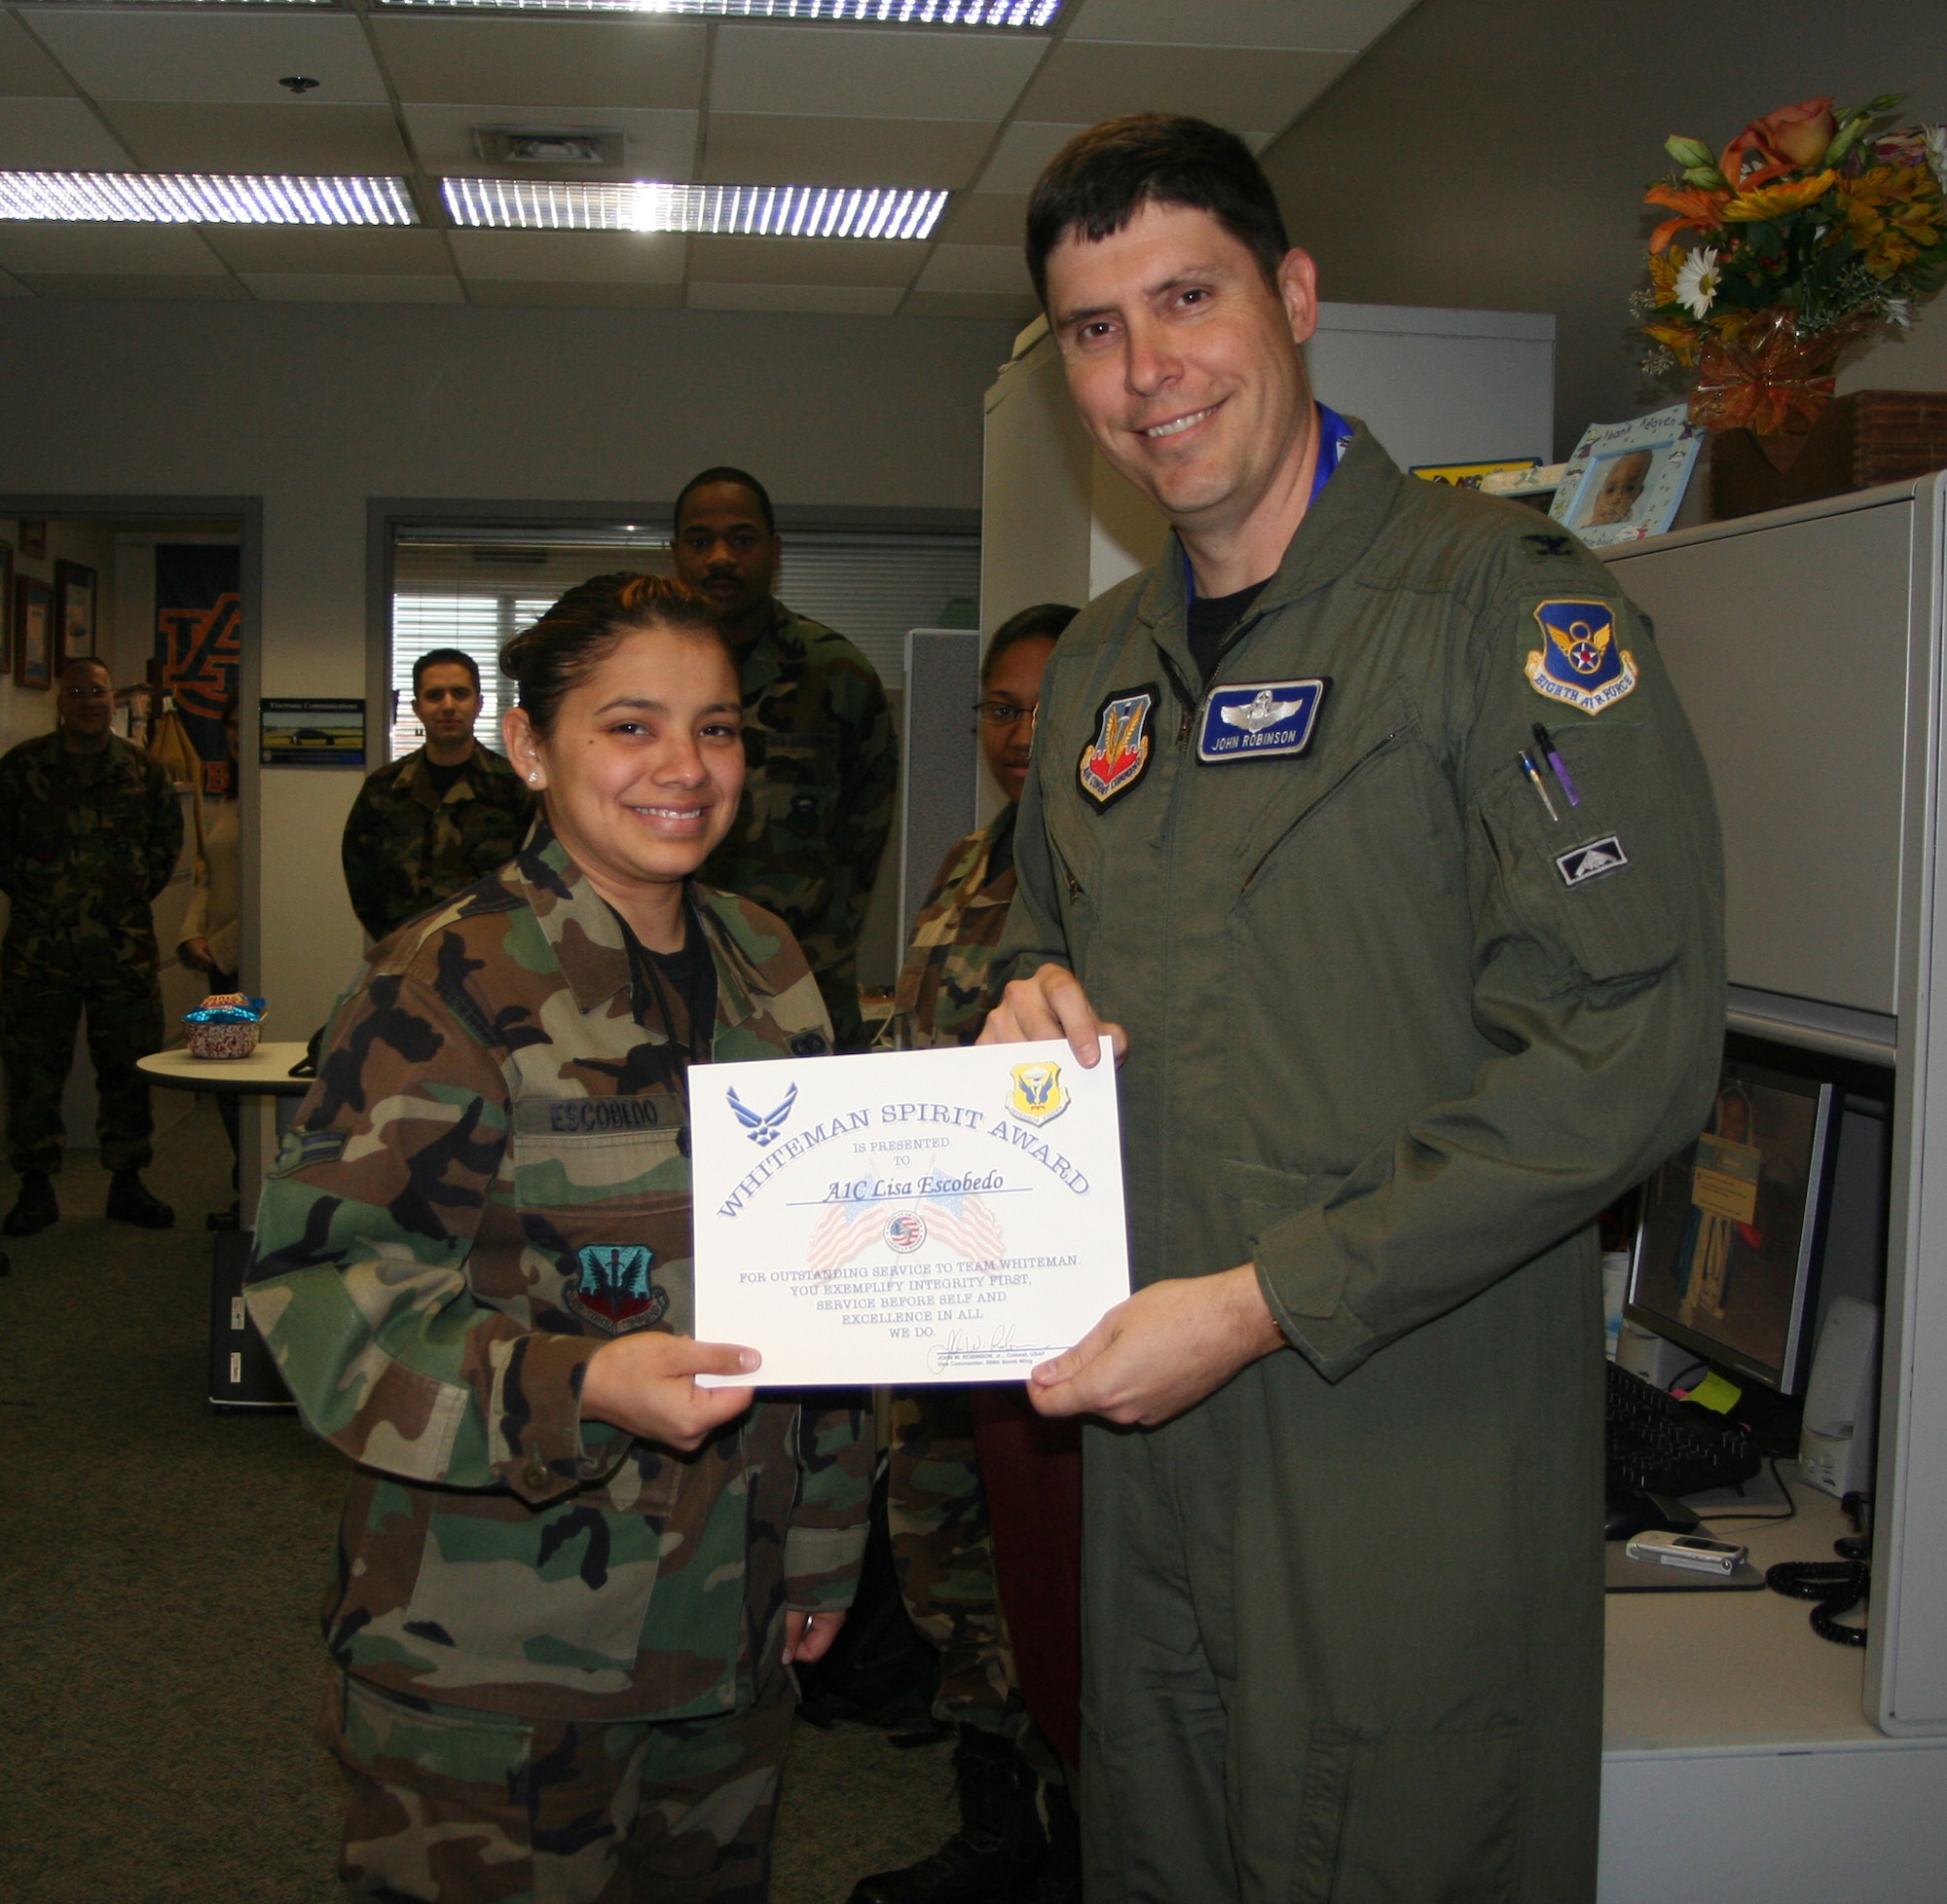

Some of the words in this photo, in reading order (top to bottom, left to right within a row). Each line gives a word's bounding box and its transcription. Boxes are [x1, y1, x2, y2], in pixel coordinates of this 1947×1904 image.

[1534, 674, 1579, 702] EIGHTH
[1580, 694, 1605, 710] AIR
[1601, 675, 1634, 701] FORCE
[1211, 735, 1239, 751] JOHN
[1241, 730, 1297, 748] ROBINSON
[550, 1099, 659, 1132] ESCOBEDO
[853, 1142, 866, 1153] IS
[870, 1137, 950, 1153] PRESENTED
[716, 1108, 871, 1218] WHITEMAN
[880, 1103, 984, 1130] SPIRIT
[986, 1120, 1090, 1196] AWARD
[893, 1154, 911, 1167] TO
[822, 1180, 868, 1203] A1C
[871, 1177, 913, 1198] Lisa
[916, 1169, 1004, 1195] Escobedo
[739, 1272, 767, 1283] FOR
[770, 1267, 868, 1282] OUTSTANDING
[872, 1263, 932, 1277] SERVICE
[936, 1263, 953, 1273] TO
[956, 1260, 997, 1273] TEAM
[790, 1285, 819, 1297] YOU
[823, 1281, 904, 1296] EXEMPLIFY
[908, 1276, 985, 1291] INTEGRITY
[989, 1273, 1032, 1287] FIRST,
[816, 1298, 876, 1311] SERVICE
[880, 1295, 936, 1308] BEFORE
[938, 1292, 974, 1305] SELF
[976, 1291, 1007, 1303] AND
[842, 1310, 933, 1326] EXCELLENCE
[937, 1309, 953, 1321] IN
[957, 1308, 983, 1320] ALL
[889, 1327, 911, 1339] WE
[915, 1326, 937, 1338] DO.
